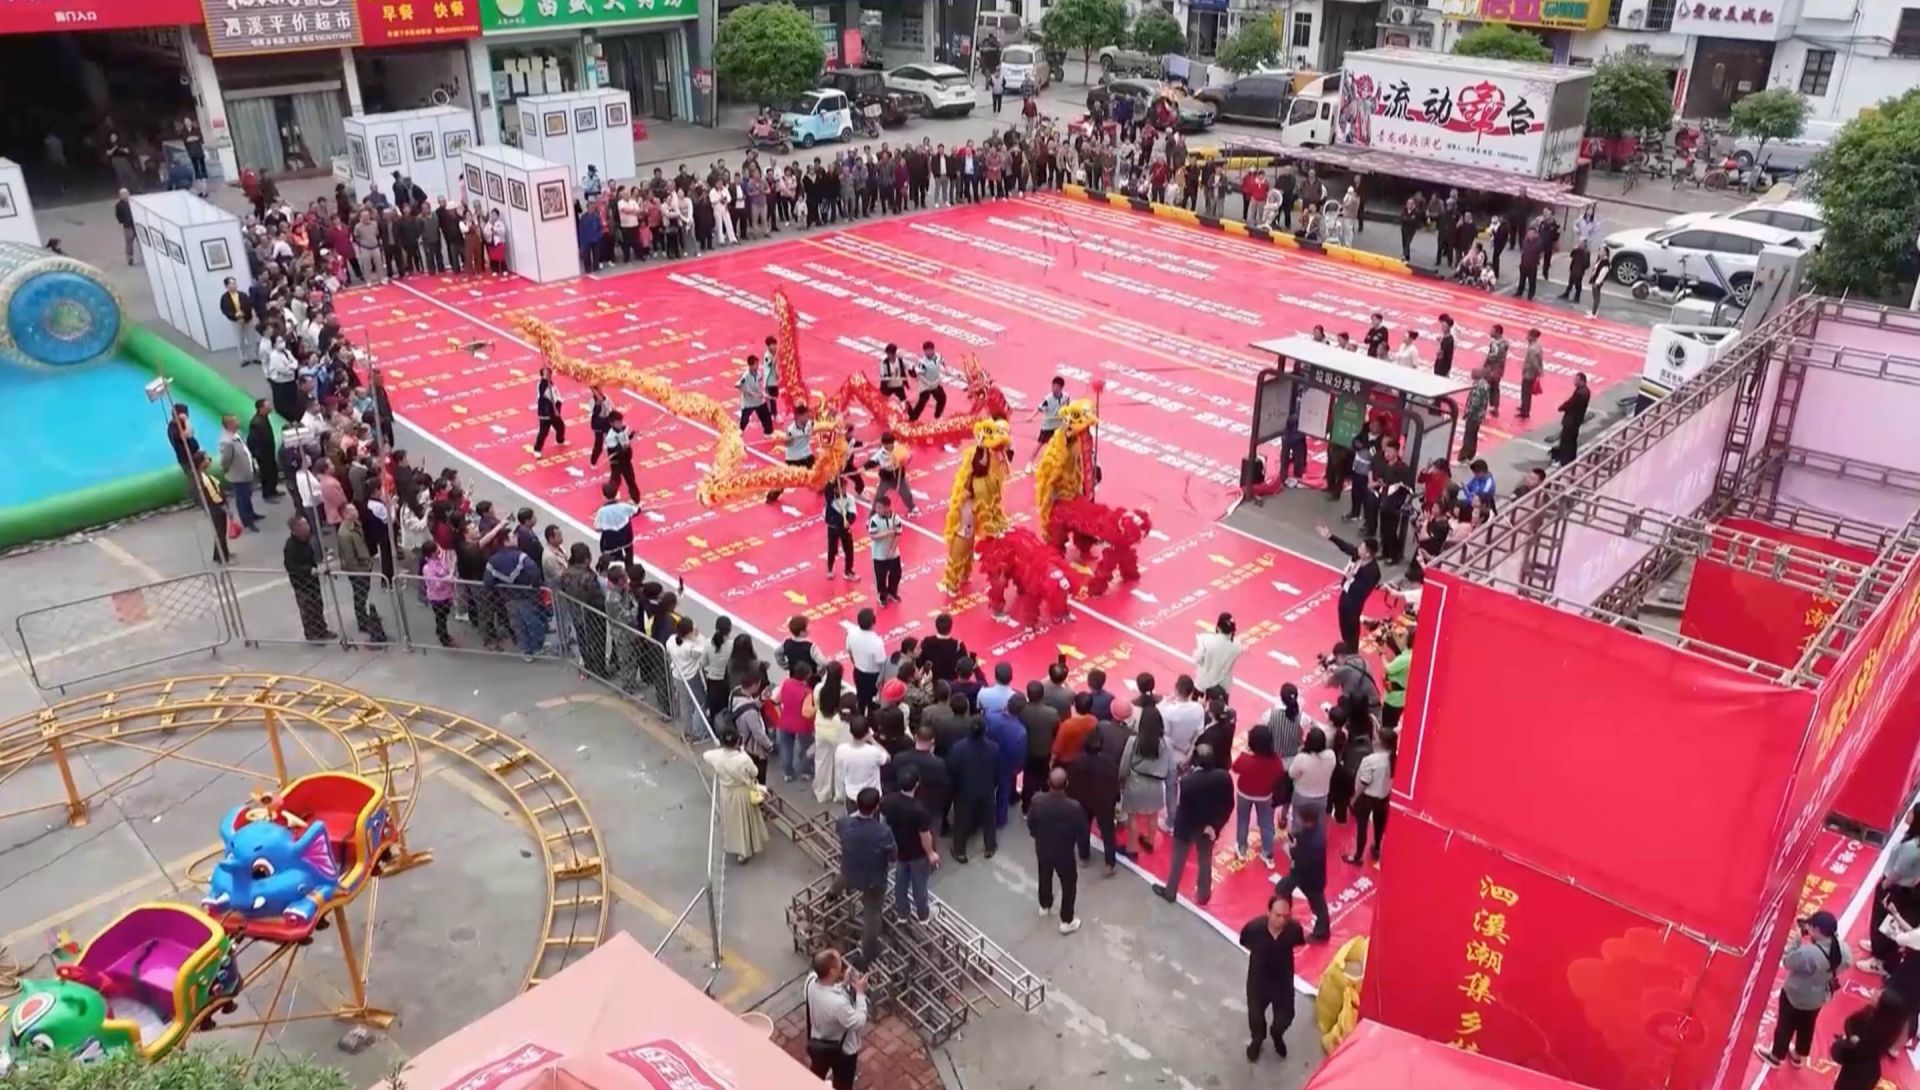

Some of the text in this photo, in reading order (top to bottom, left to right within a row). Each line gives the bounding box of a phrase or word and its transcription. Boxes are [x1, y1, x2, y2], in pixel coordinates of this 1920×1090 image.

[223, 10, 351, 37] 泗溪平价超市
[1383, 80, 1535, 146] 流动舞台
[1316, 370, 1361, 394] 垃圾分类亭
